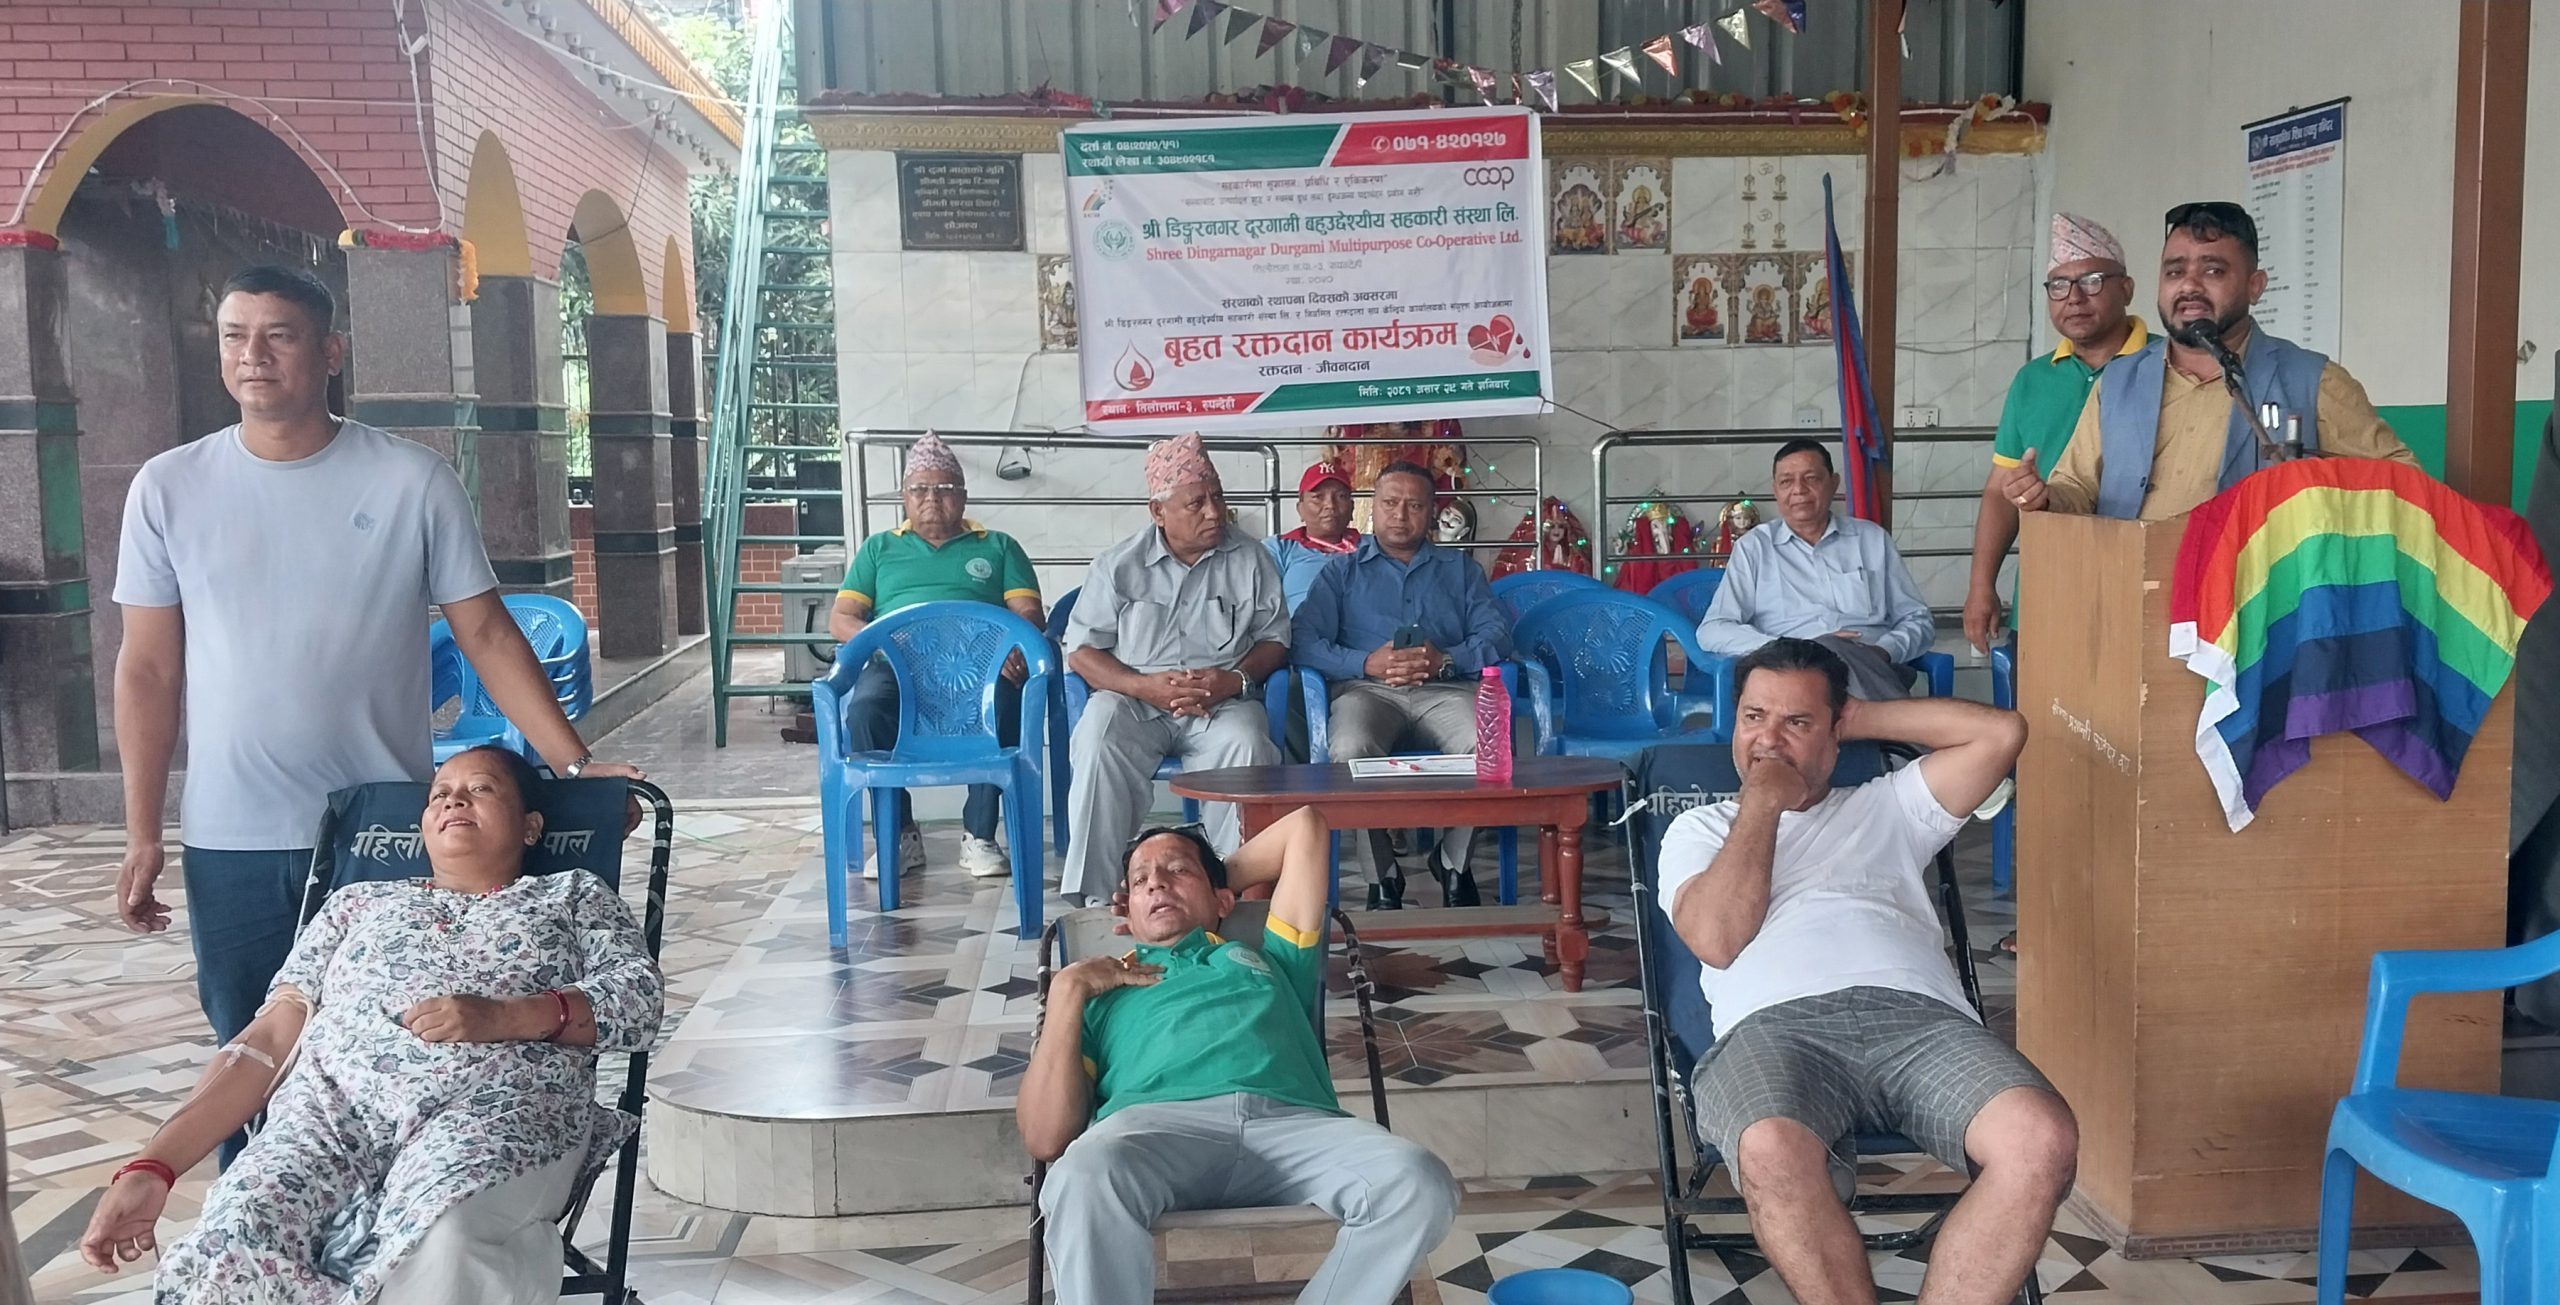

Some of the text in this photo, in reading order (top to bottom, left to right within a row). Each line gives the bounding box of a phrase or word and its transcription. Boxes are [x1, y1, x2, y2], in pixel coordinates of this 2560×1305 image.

[1115, 155, 1139, 167] लेखा
[1142, 217, 1160, 240] श्री
[1245, 212, 1300, 239] दूरगामी
[1390, 205, 1448, 229] सहकारी
[1453, 205, 1491, 225] संस्था
[1496, 202, 1519, 223] लि.
[1146, 231, 1523, 262] Shree Dingarnagar Durgami Multipurpose Co-Operative Ltd.
[1221, 290, 1398, 309] संस्थाको स्थापना दिवसको अवसरमा
[1164, 319, 1459, 368] बृहत रक्तदान कार्यक्रम
[1258, 364, 1303, 377] रक्तदान
[1316, 360, 1370, 374] जीवनदान
